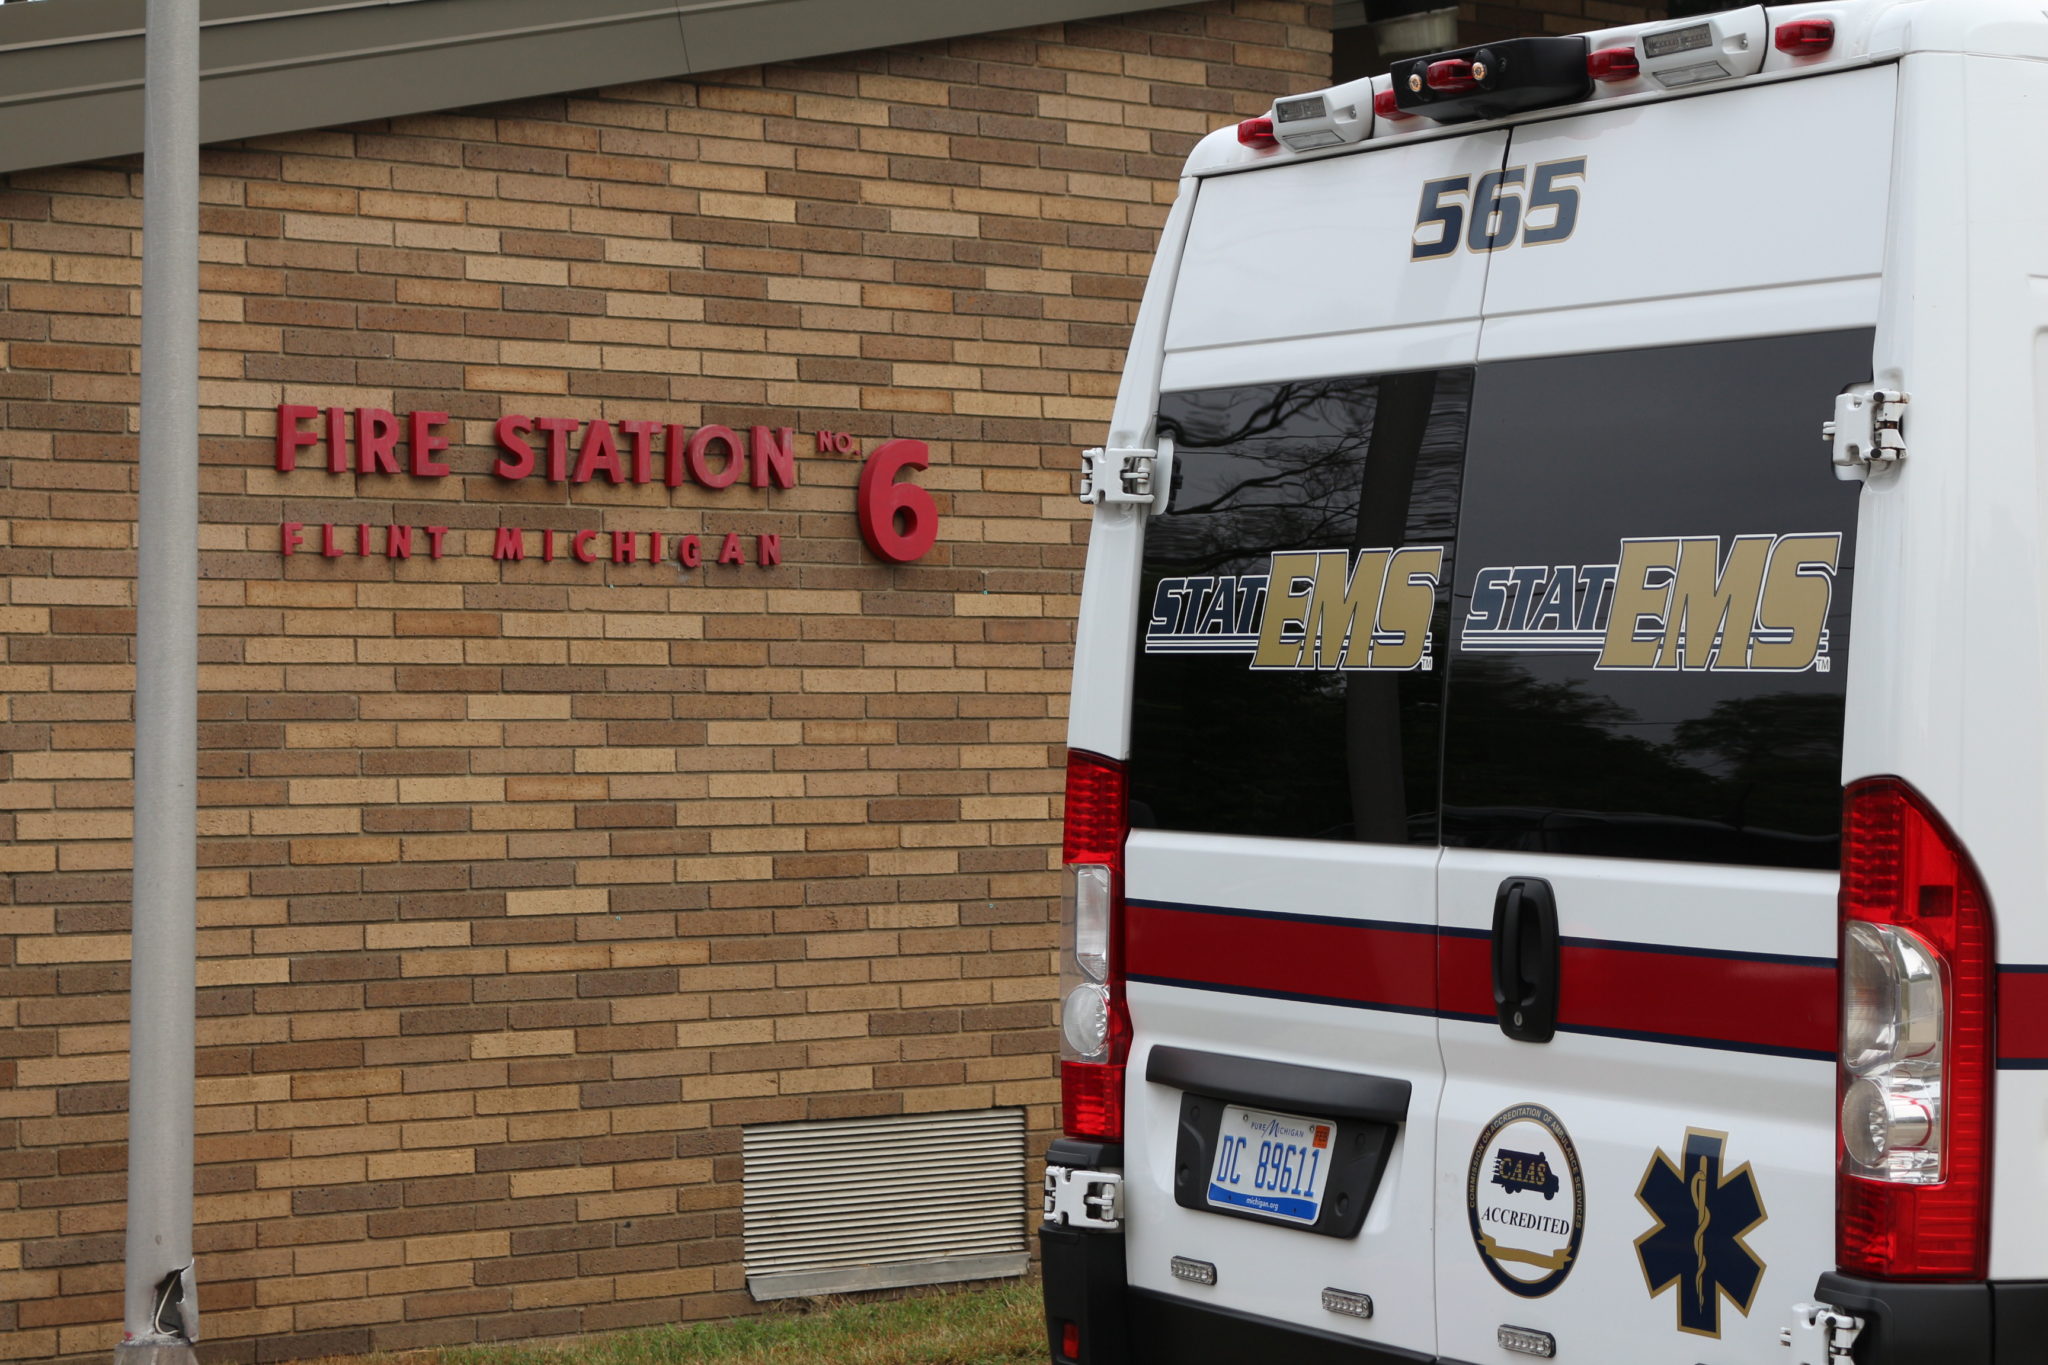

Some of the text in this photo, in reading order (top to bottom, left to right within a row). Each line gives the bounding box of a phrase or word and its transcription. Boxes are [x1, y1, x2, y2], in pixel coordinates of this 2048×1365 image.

[1410, 155, 1588, 263] 565
[276, 404, 450, 477] FIRE
[493, 415, 794, 490] STATION
[857, 438, 938, 563] 6
[281, 522, 782, 568] FLINT MICHIGAN
[1251, 1119, 1304, 1137] PURE MICHIGAN
[1216, 1135, 1320, 1198] DC 89611
[1469, 1107, 1583, 1229] COMMISSION ON ACCREDITATION OF AMBULANCE SERVICES
[1499, 1157, 1547, 1185] CAAS
[1246, 1197, 1279, 1211] michigan.org
[1481, 1206, 1569, 1235] ACCREDITED
